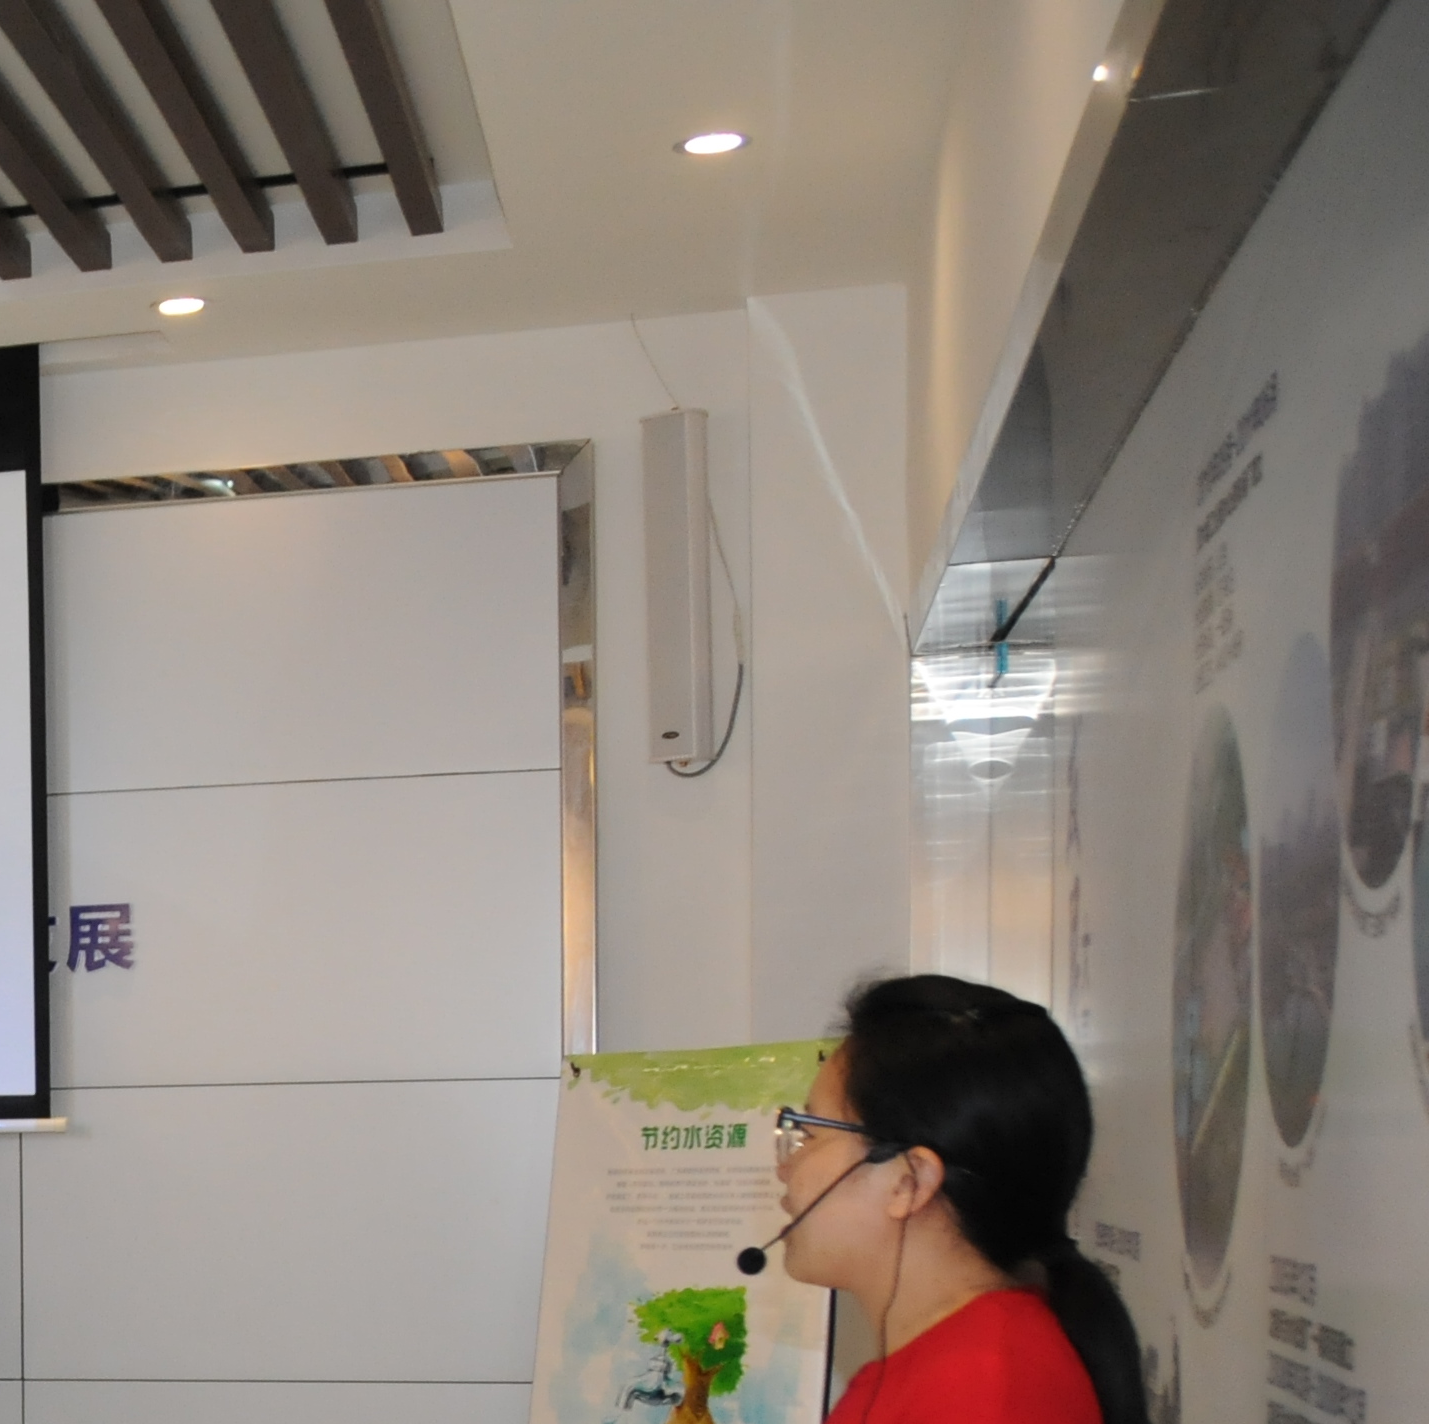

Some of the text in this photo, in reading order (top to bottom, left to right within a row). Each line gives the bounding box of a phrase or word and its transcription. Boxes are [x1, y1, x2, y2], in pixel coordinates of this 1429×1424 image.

[49, 903, 134, 972] 展
[640, 1122, 749, 1151] 节约水资源
